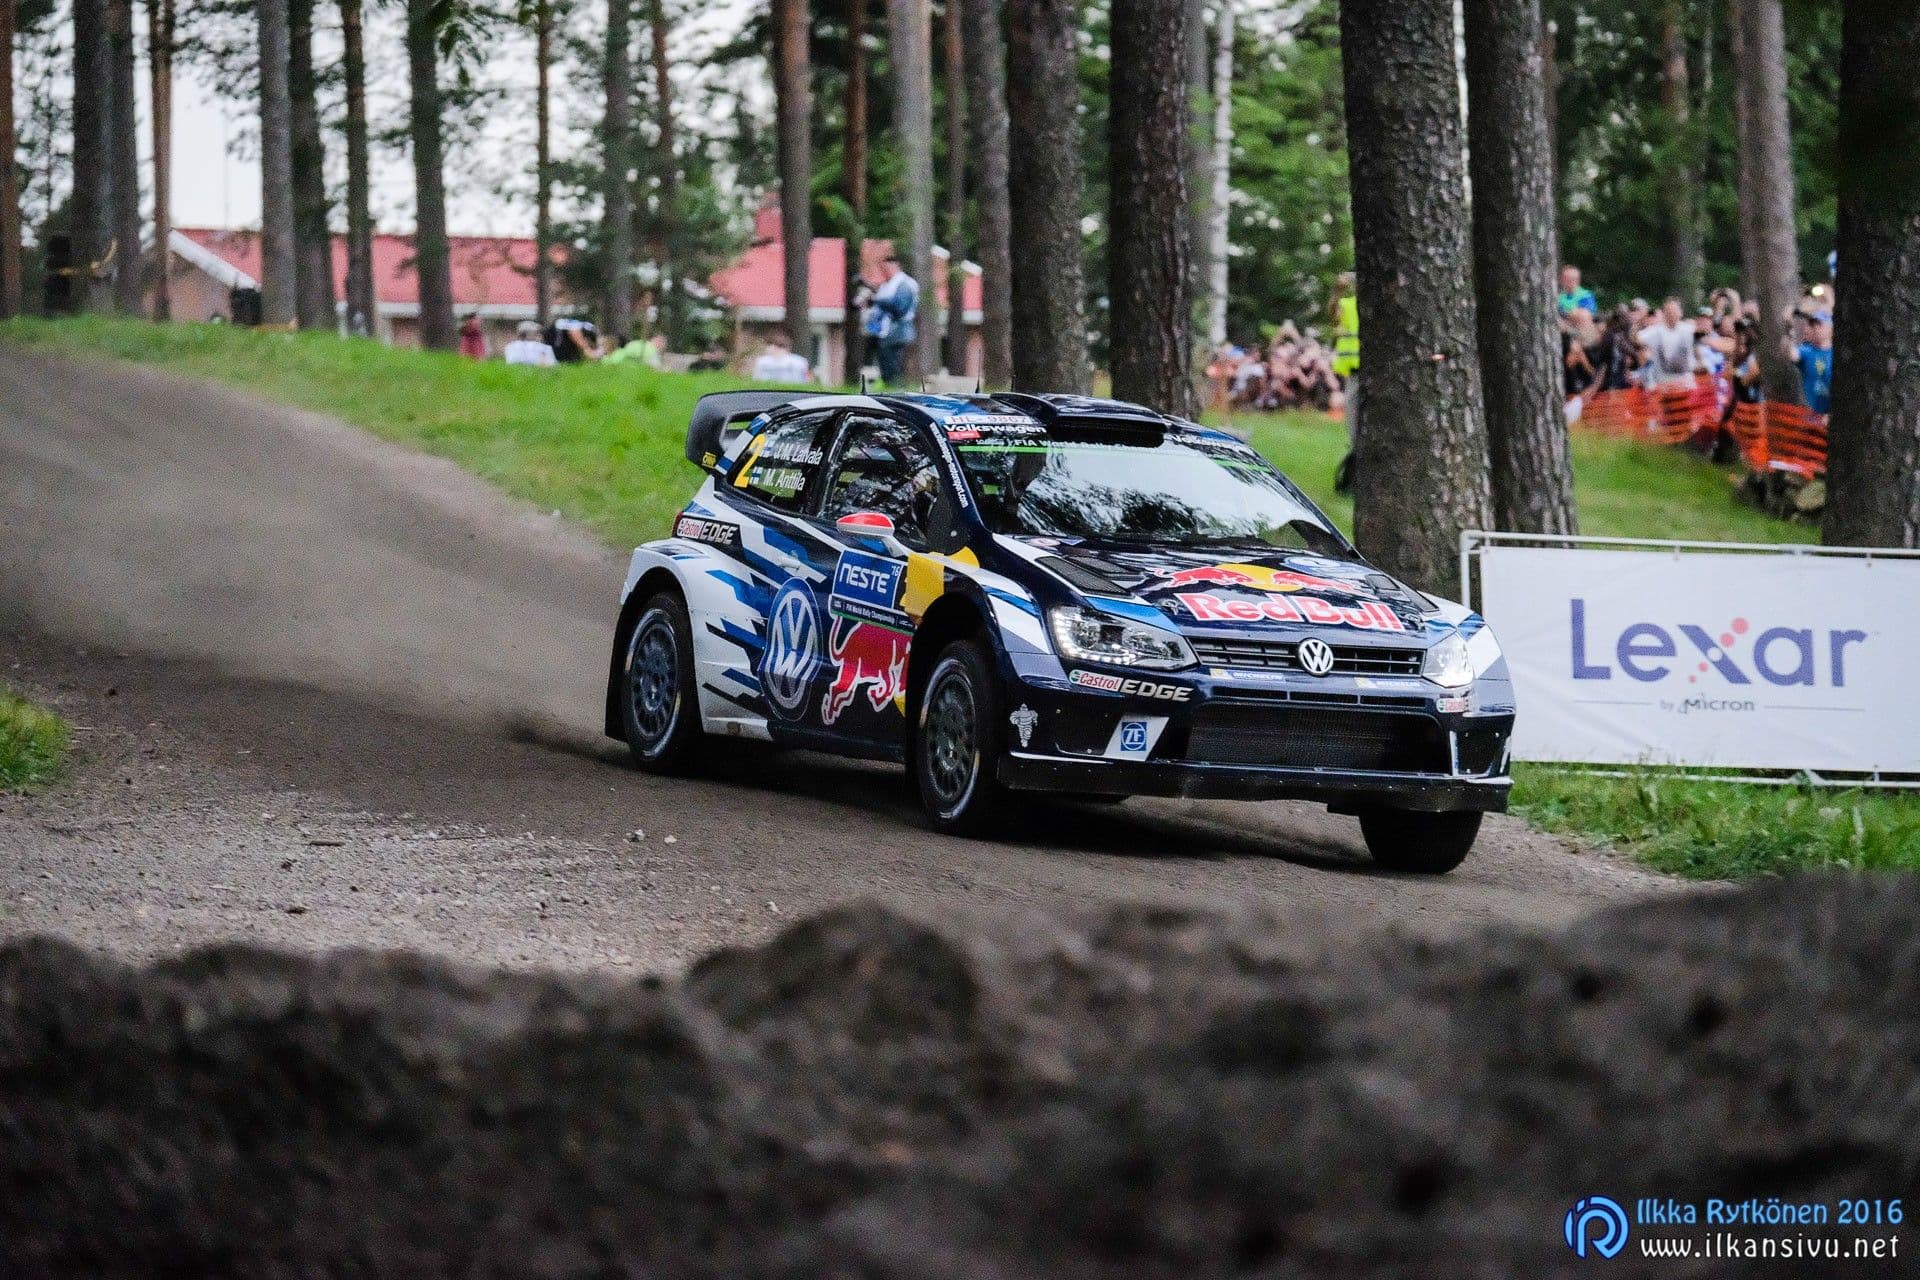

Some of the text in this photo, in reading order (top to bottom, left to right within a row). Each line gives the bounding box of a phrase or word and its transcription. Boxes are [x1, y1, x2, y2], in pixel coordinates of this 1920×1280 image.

[943, 424, 1047, 434] Volkswagen
[733, 433, 767, 488] 2
[775, 471, 806, 491] Anttila
[701, 522, 739, 545] EDGE
[838, 562, 891, 594] NESTE
[1175, 592, 1406, 633] Red Bull
[1570, 598, 1868, 687] Lexar
[1079, 670, 1195, 702] Castrol EDGE
[1678, 692, 1755, 714] Micron
[1124, 726, 1144, 747] ZF
